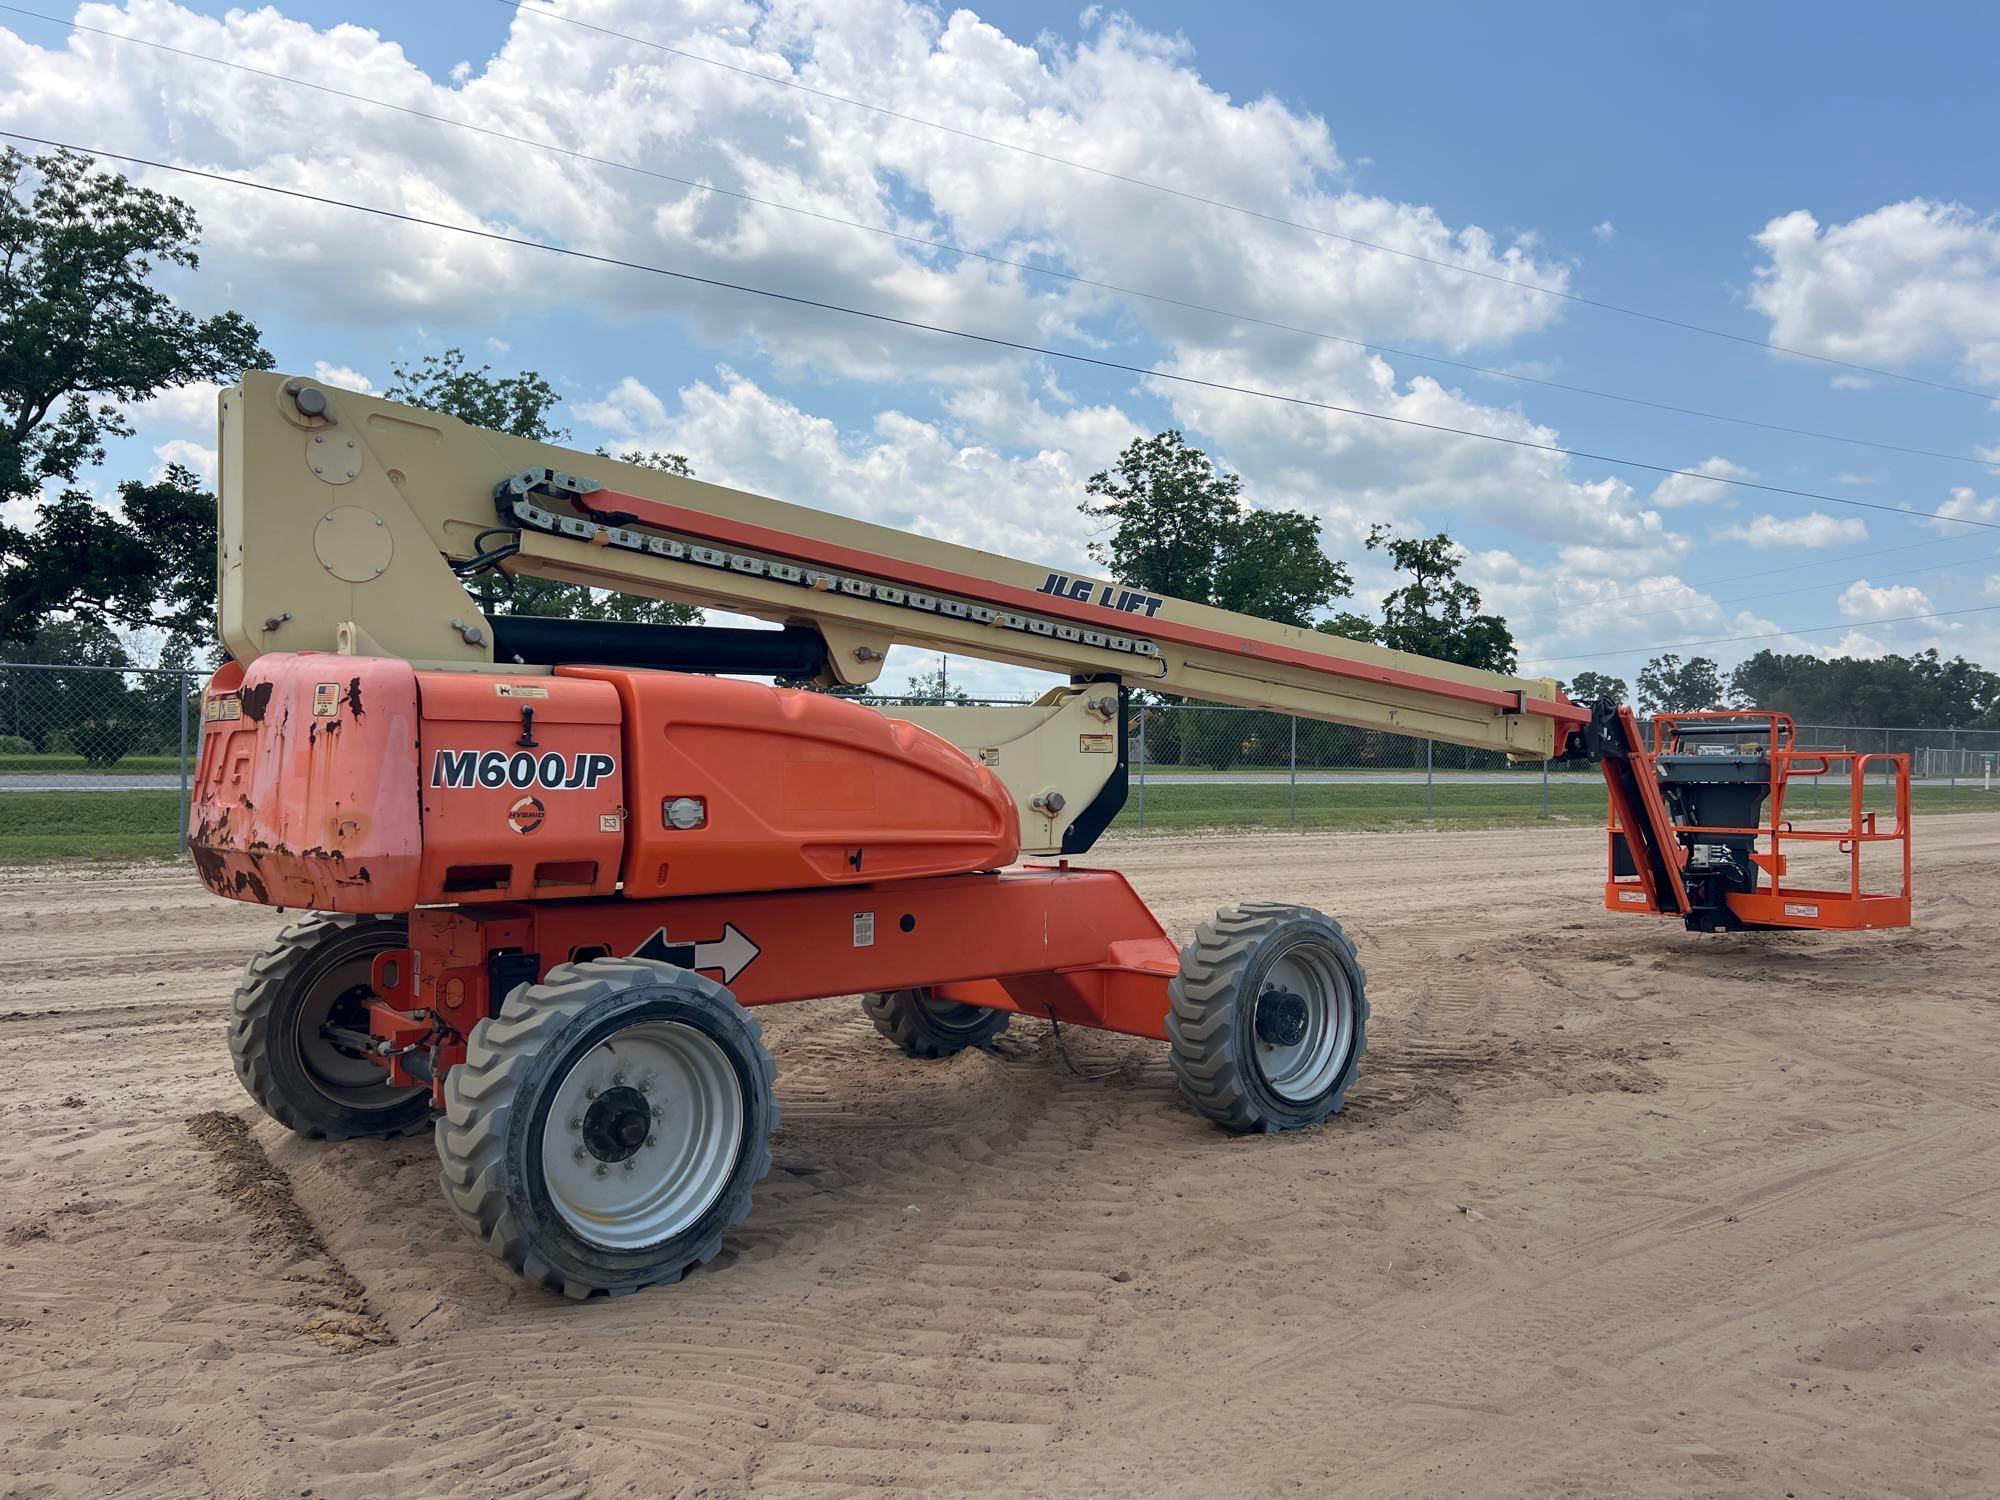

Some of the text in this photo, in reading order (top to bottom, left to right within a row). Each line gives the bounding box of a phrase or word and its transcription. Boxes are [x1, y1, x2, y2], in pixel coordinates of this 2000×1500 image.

[1035, 573, 1163, 618] JLG LIFT
[431, 750, 616, 790] M600JP
